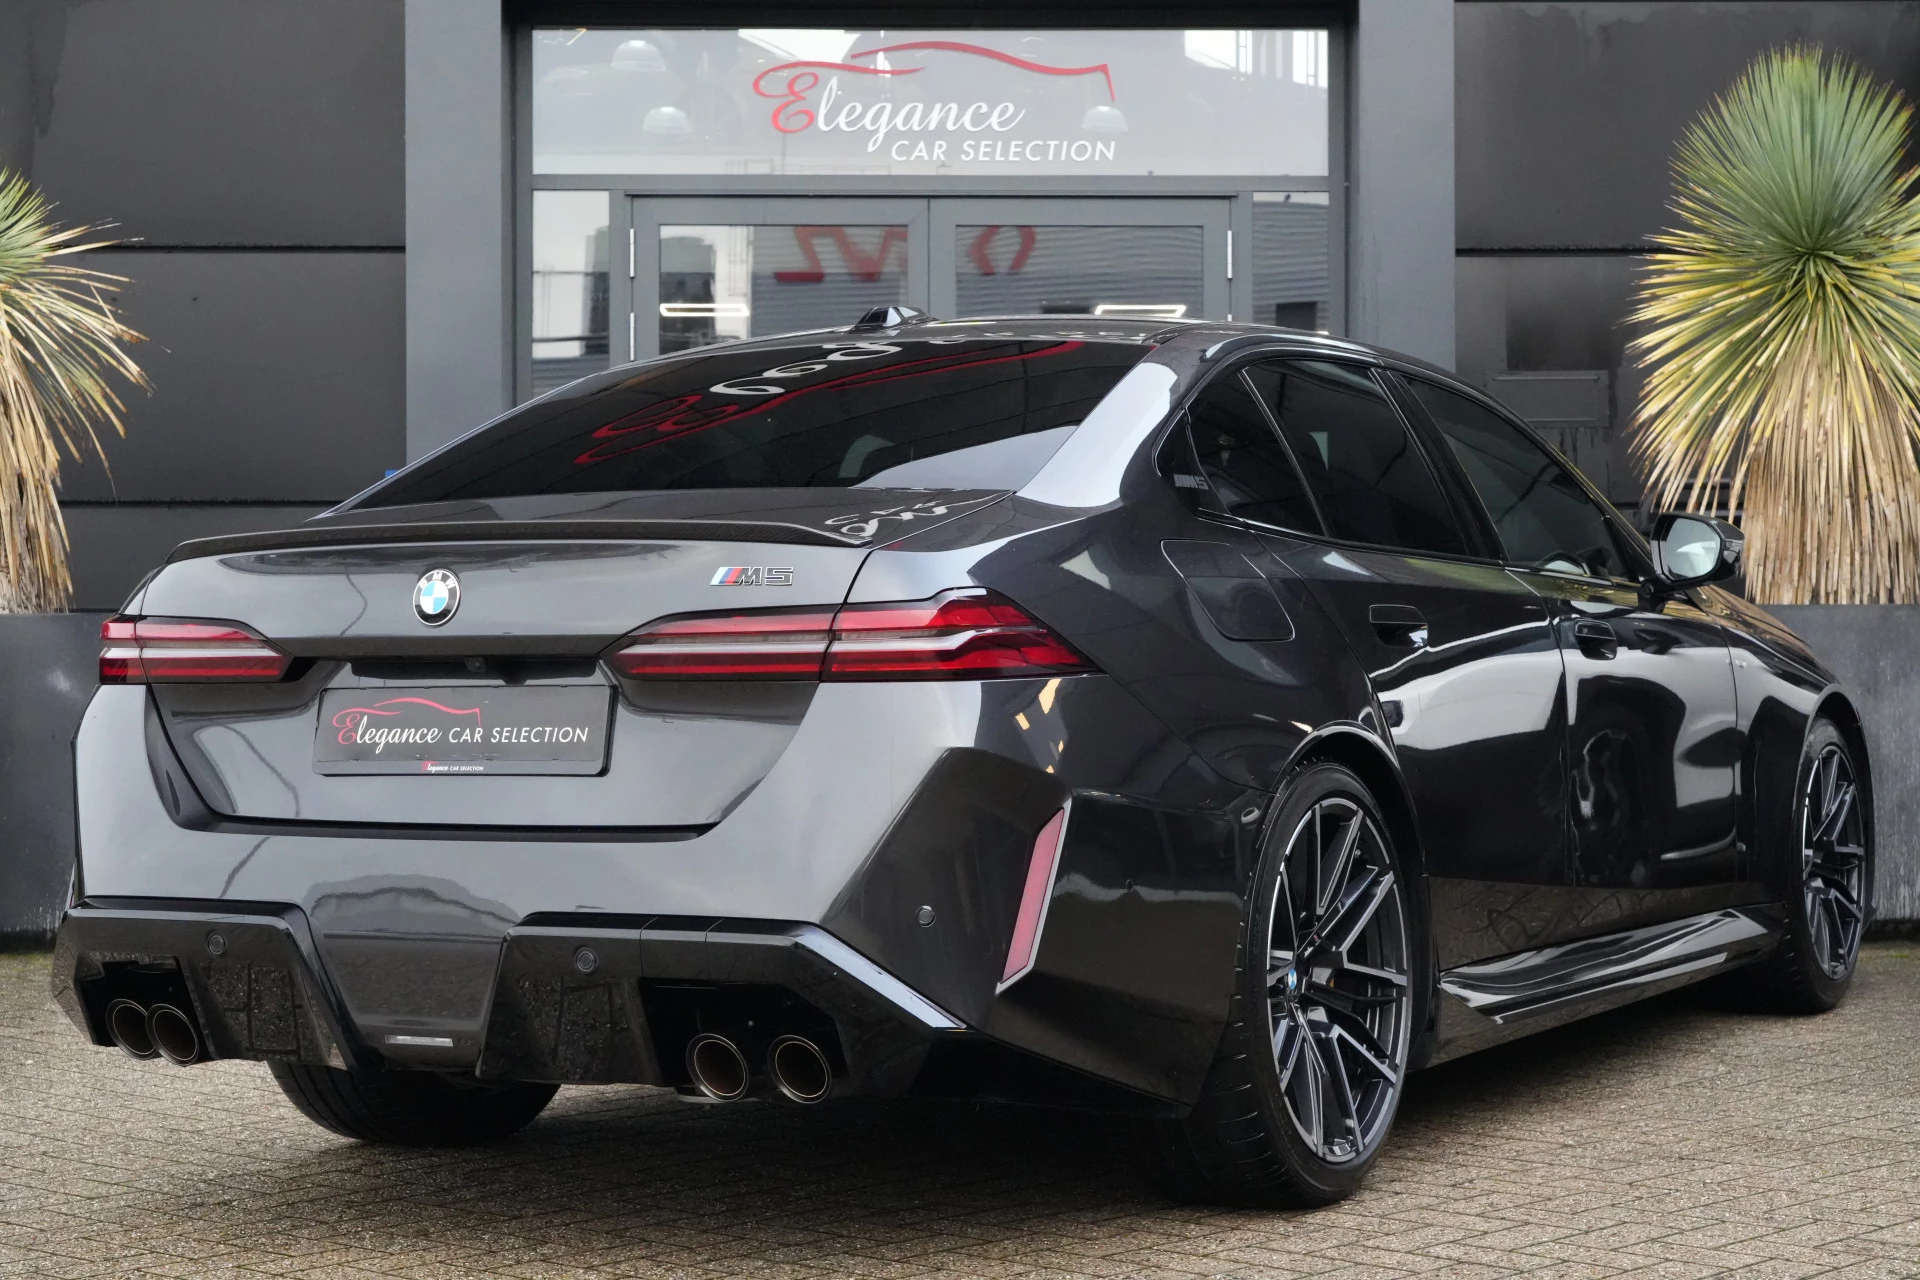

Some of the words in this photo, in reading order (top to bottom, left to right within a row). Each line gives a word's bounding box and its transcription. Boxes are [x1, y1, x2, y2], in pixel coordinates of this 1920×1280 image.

[753, 62, 1026, 153] Elegance
[890, 140, 948, 162] CAR
[960, 140, 1117, 162] SELECTION
[418, 571, 456, 589] BMW
[726, 566, 794, 586] M5
[333, 707, 442, 754] Elegance
[449, 727, 483, 743] CAR
[490, 727, 589, 743] SELECTION
